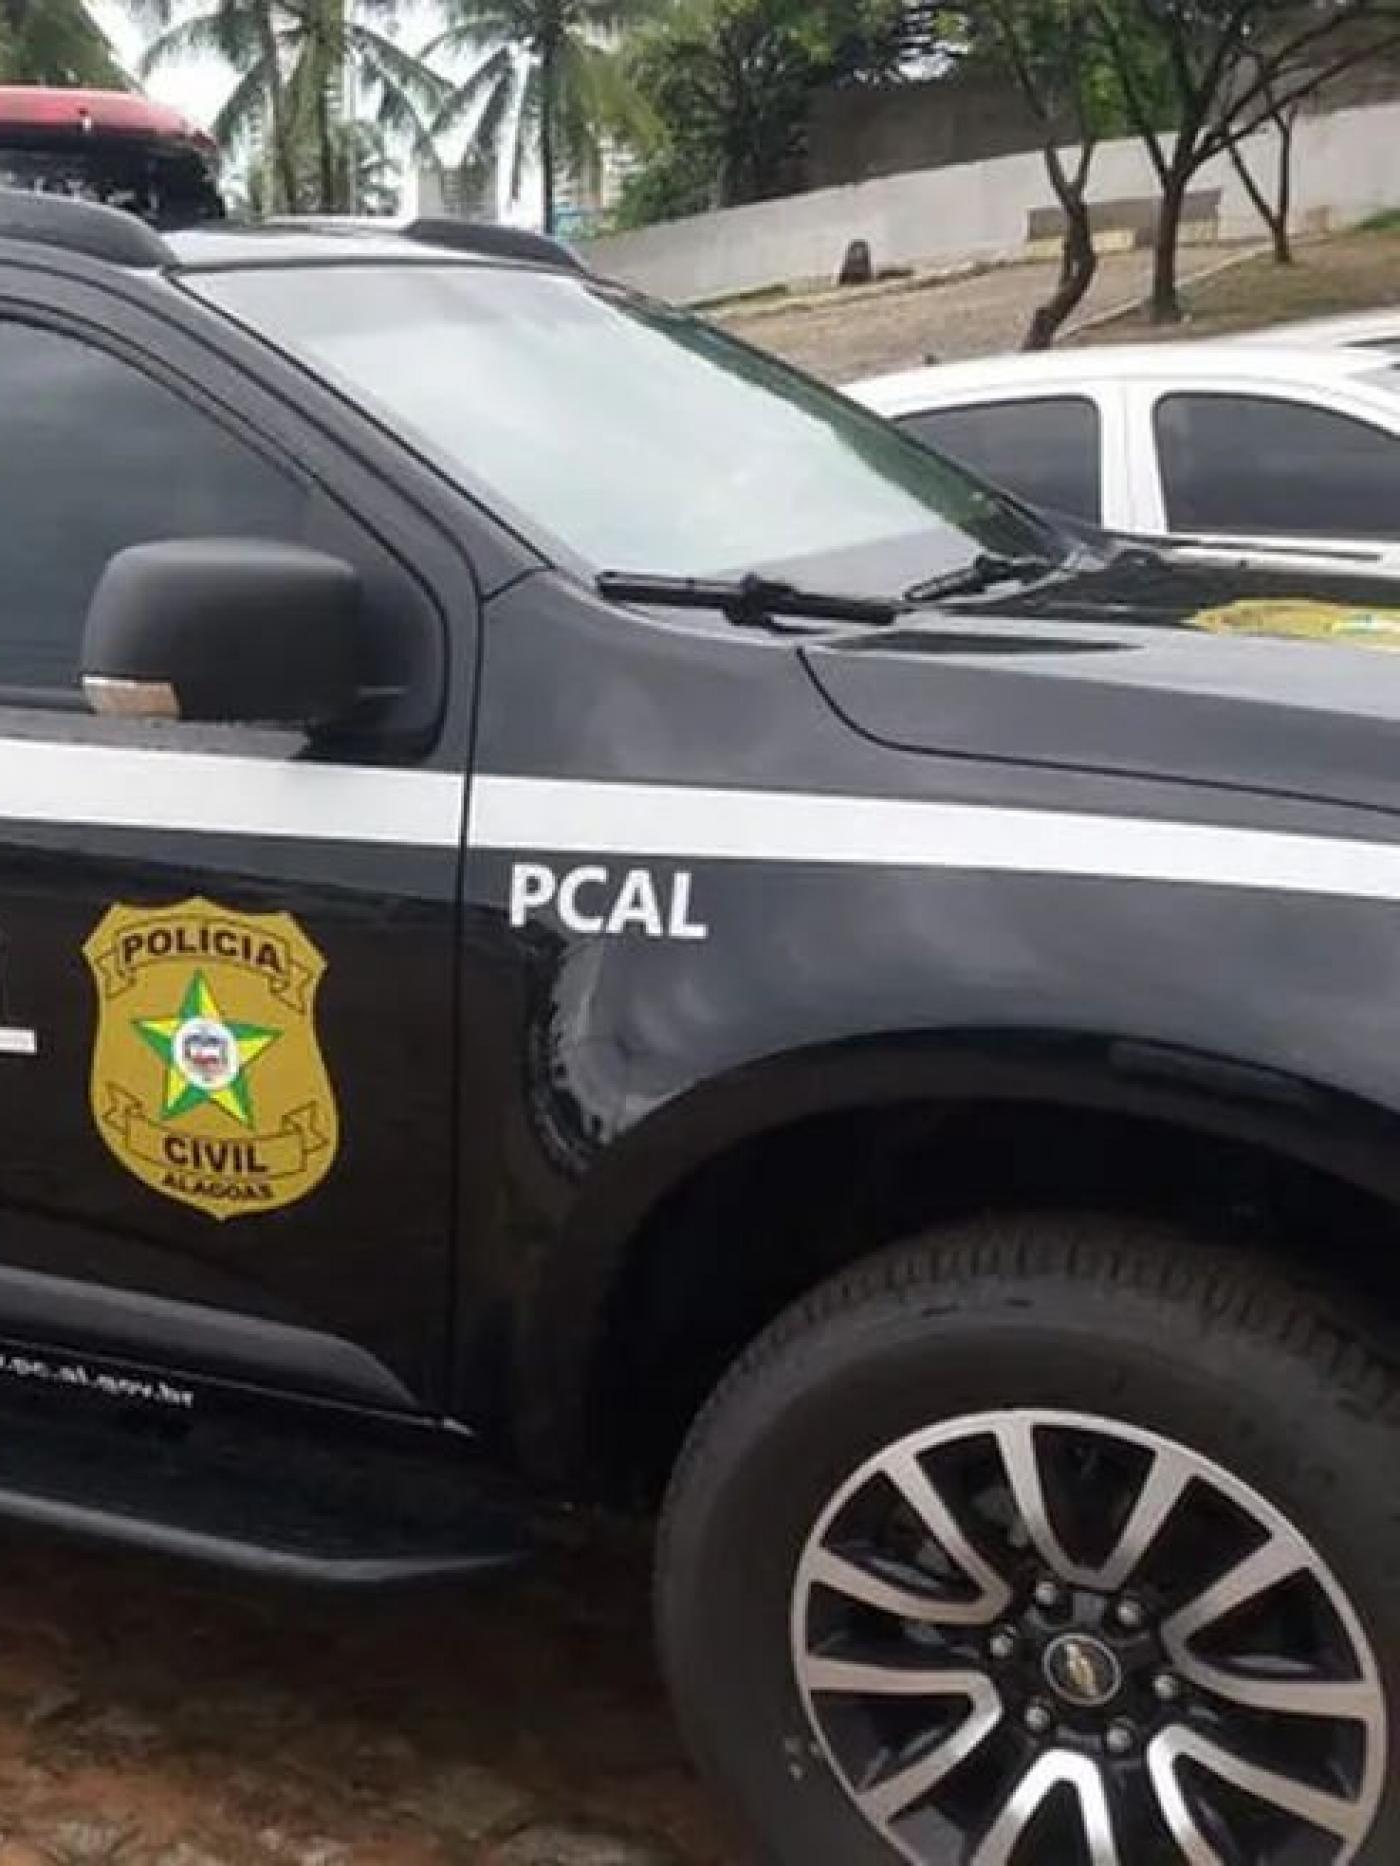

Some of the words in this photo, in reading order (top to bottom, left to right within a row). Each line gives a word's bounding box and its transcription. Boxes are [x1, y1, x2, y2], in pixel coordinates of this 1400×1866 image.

[510, 864, 708, 939] PCAL
[163, 1136, 268, 1173] CIVIL
[161, 1172, 274, 1200] ALAGOAS
